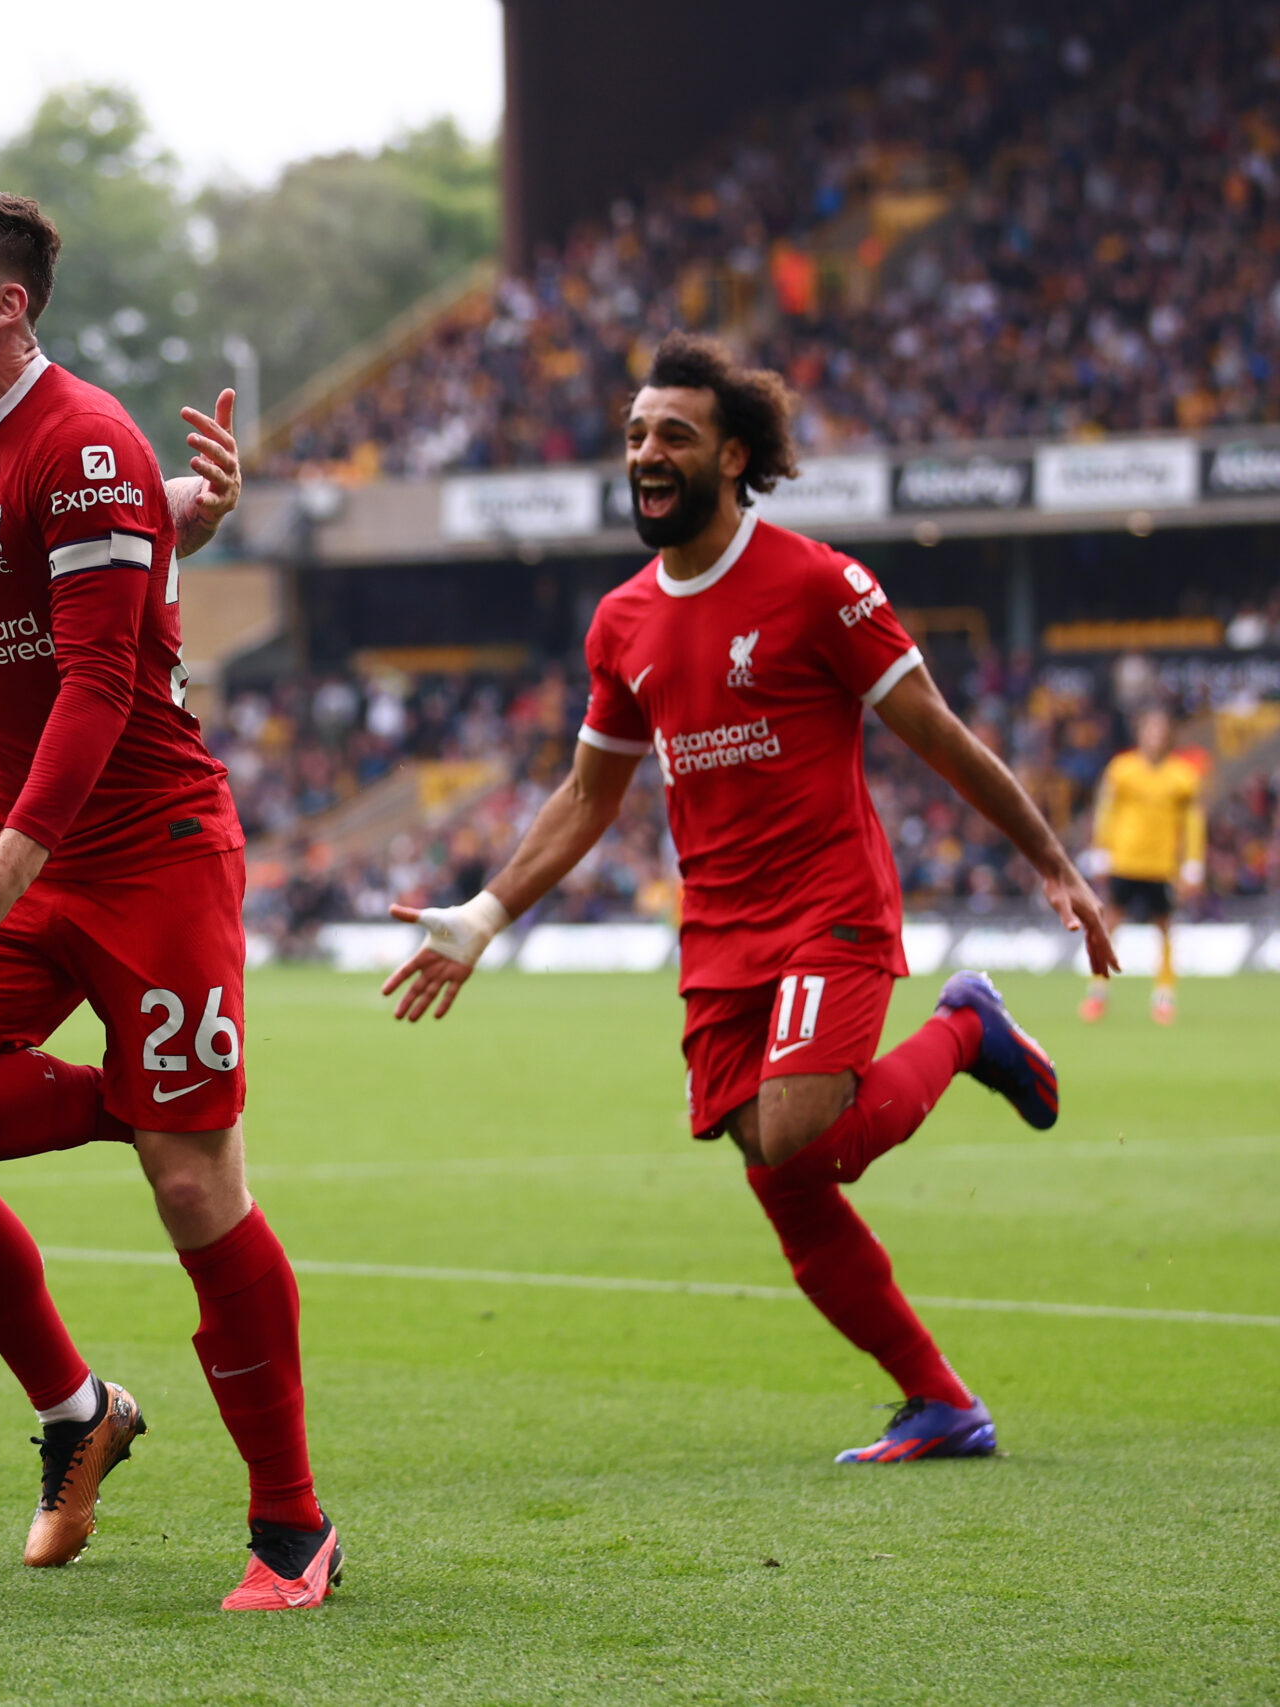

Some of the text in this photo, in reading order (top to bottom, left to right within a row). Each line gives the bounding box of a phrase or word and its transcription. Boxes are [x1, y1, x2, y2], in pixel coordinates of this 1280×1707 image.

[50, 481, 144, 515] Expedia
[670, 716, 770, 755] standard
[674, 734, 781, 775] chartered
[776, 974, 826, 1041] 11
[140, 986, 239, 1071] 26
